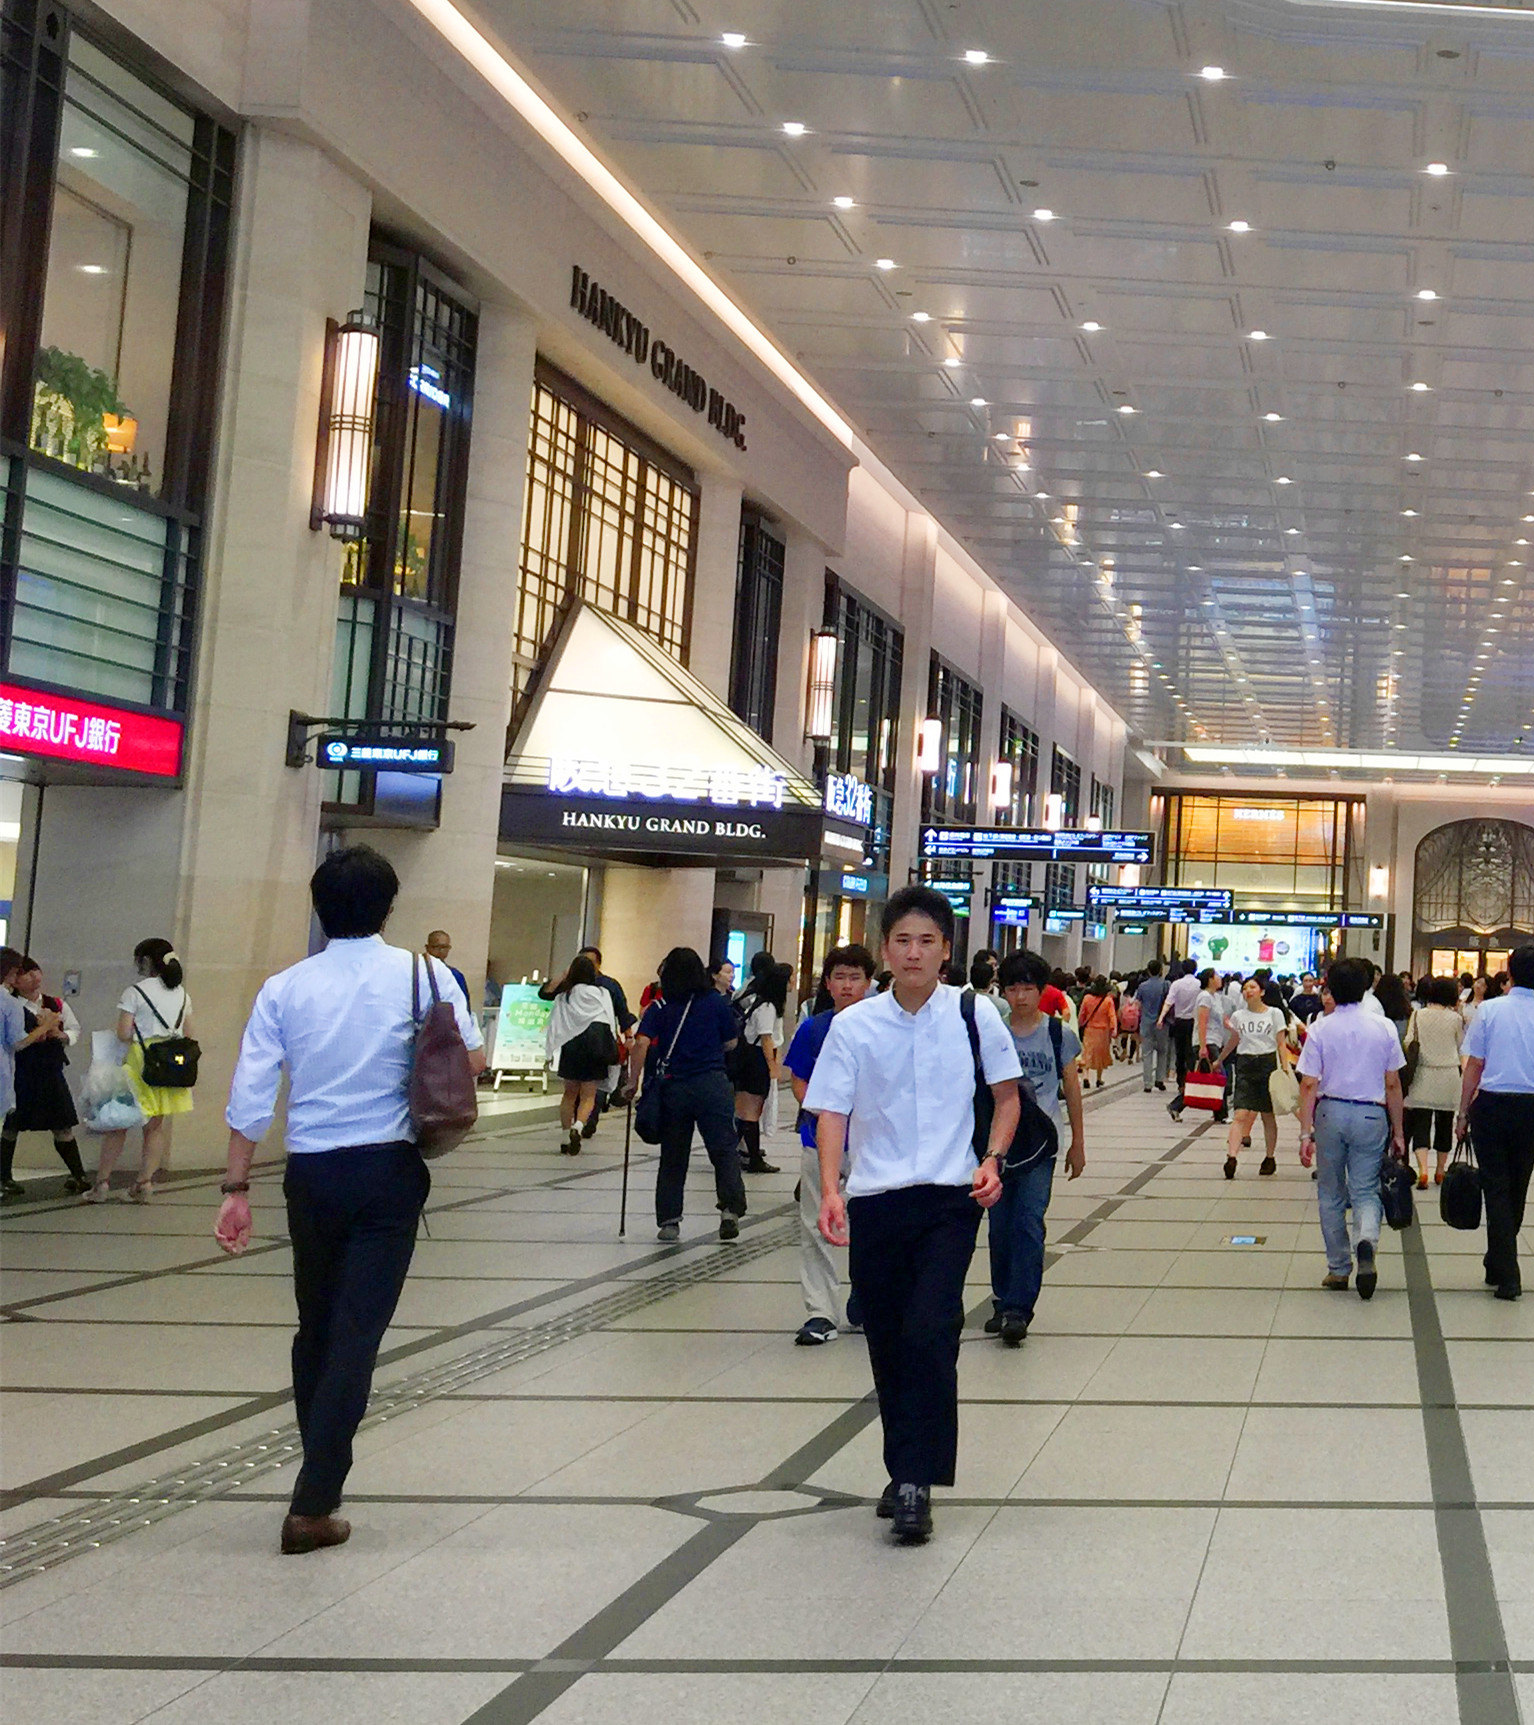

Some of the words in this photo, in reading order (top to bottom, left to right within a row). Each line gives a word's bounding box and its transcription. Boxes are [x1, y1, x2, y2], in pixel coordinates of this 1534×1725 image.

[570, 265, 649, 364] HANKYU
[651, 340, 707, 413] GRAND
[562, 812, 640, 830] HANKYU
[646, 818, 710, 835] GRAND
[715, 822, 767, 839] BLDG.
[515, 1008, 551, 1018] Monday
